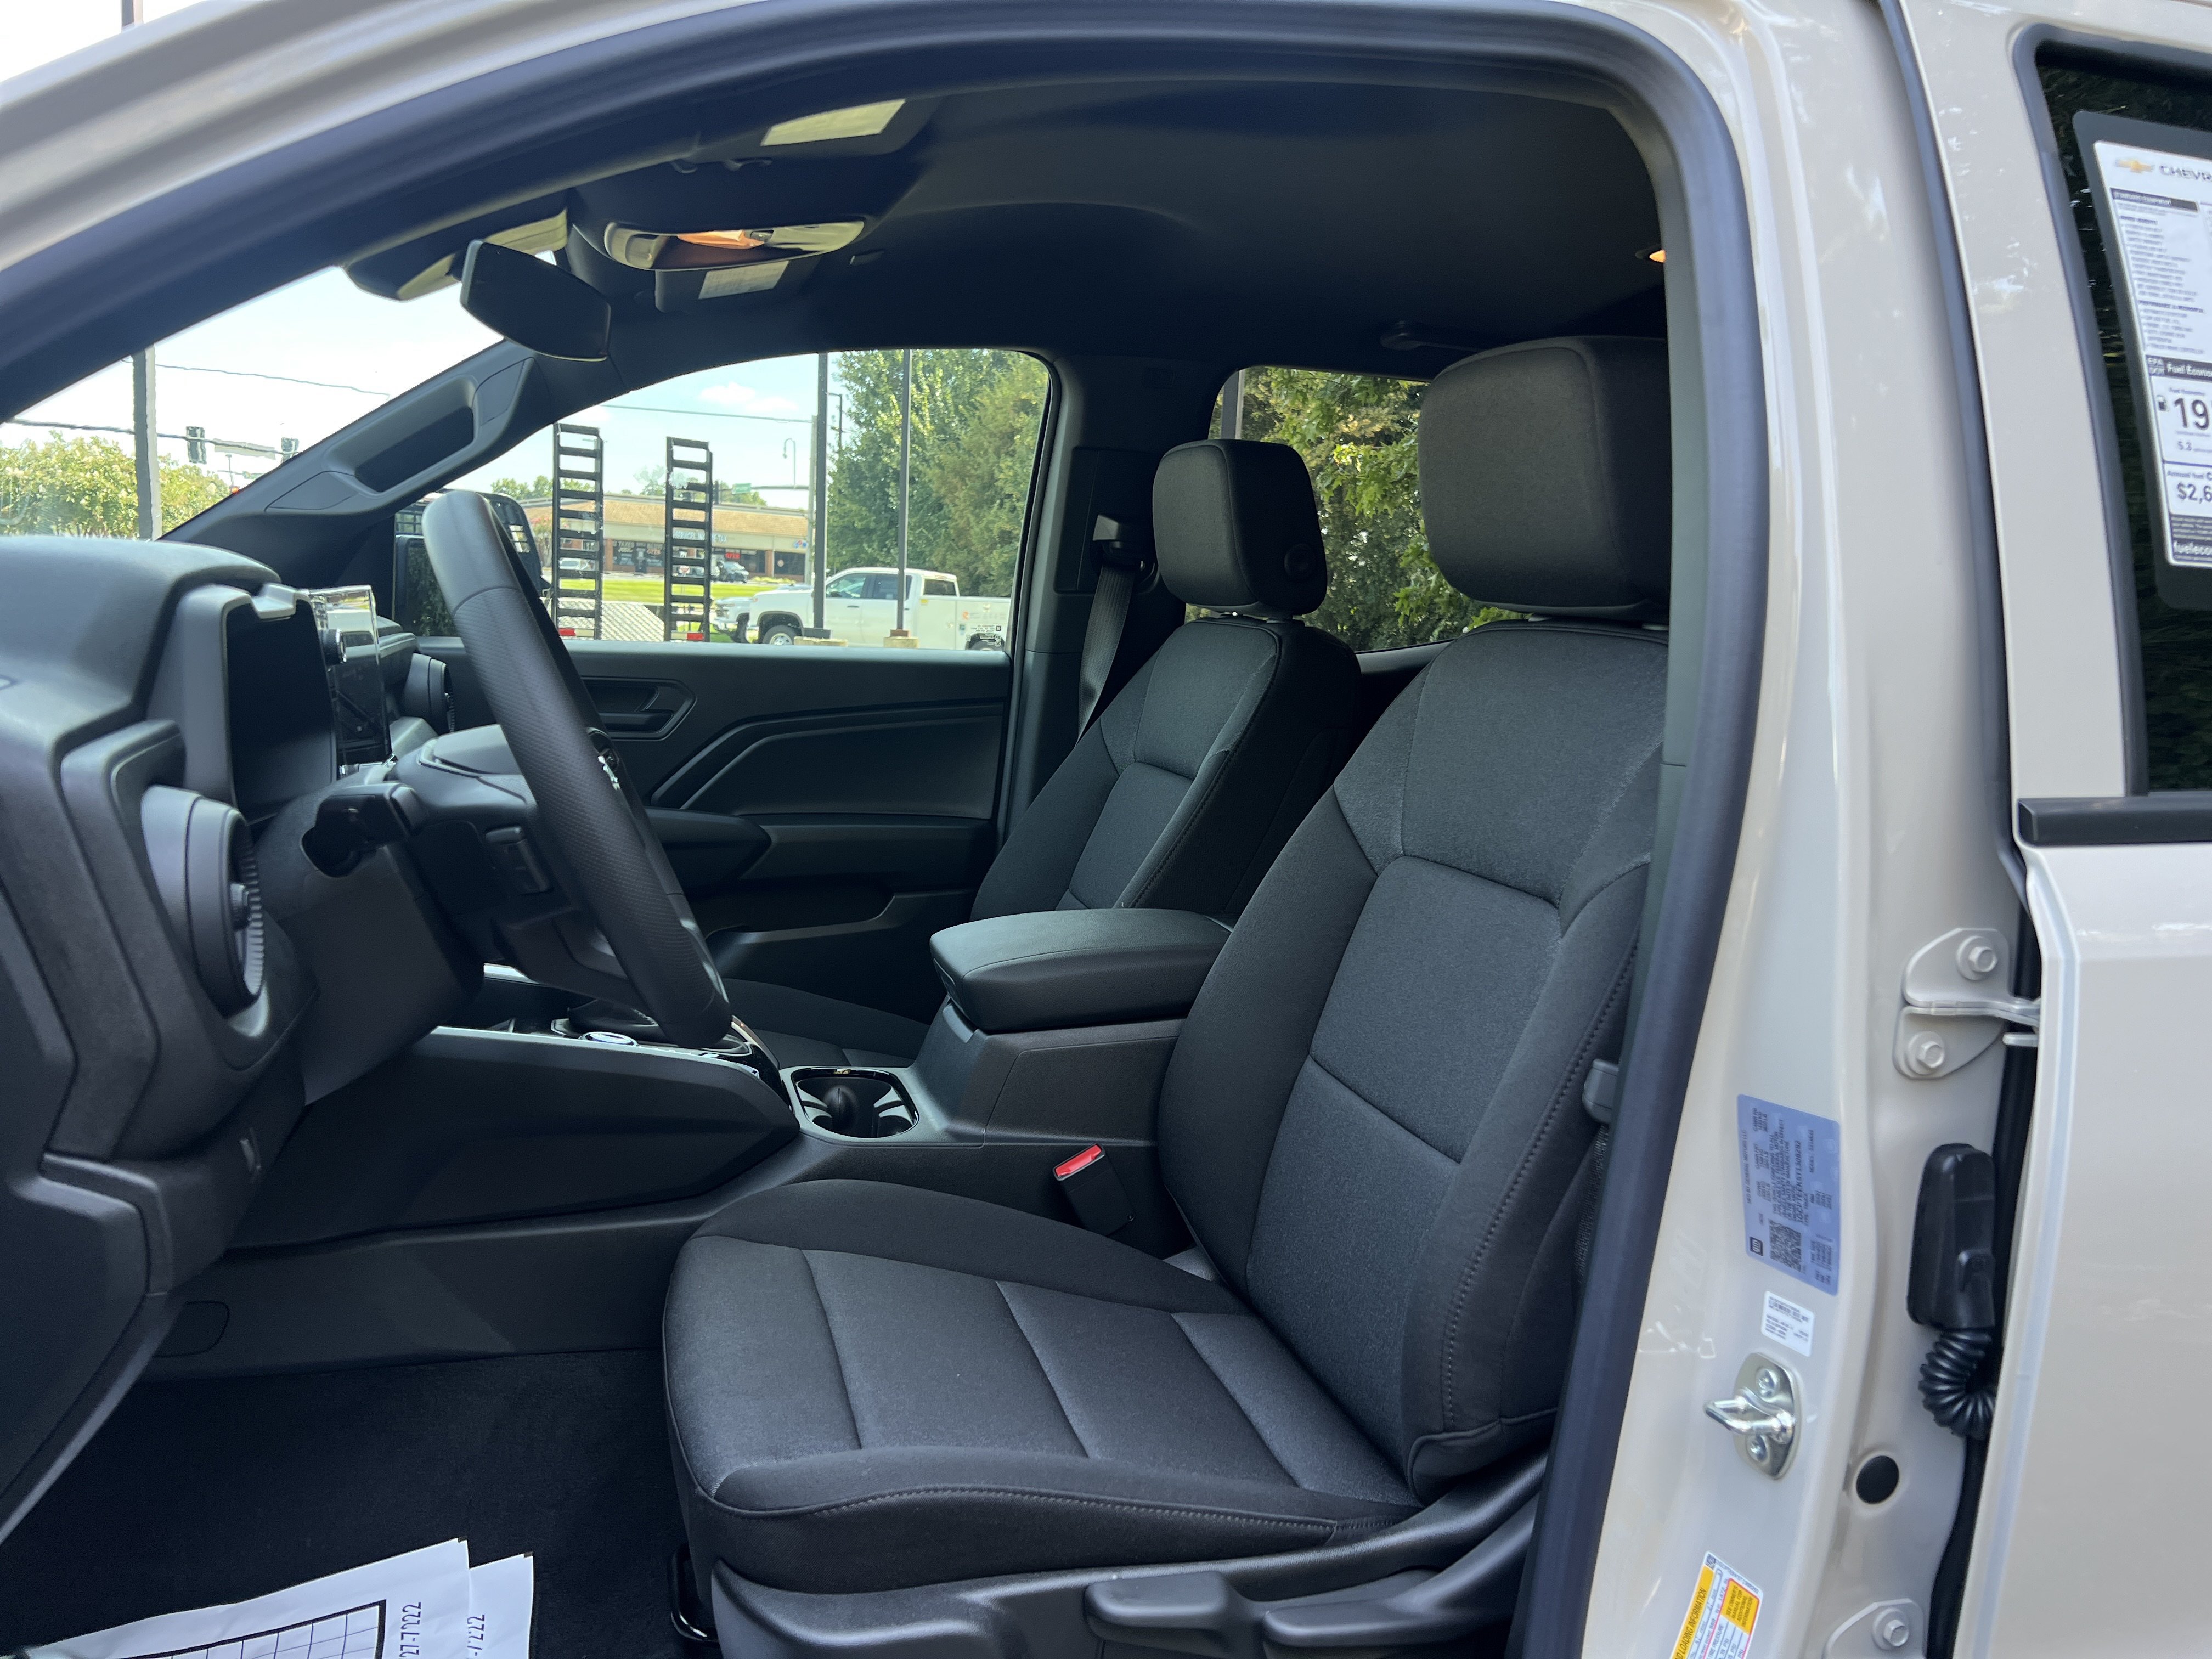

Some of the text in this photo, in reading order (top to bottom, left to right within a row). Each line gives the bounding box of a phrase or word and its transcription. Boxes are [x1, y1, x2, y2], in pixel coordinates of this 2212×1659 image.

[2166, 362, 2186, 374] Fuel
[2173, 397, 2210, 431] 19
[2177, 441, 2192, 451] 5.3
[2177, 482, 2212, 503] $2,6
[1752, 1238, 1760, 1254] gm
[1679, 1626, 1694, 1654] LOADING
[1688, 1587, 1707, 1628] INFORMATION
